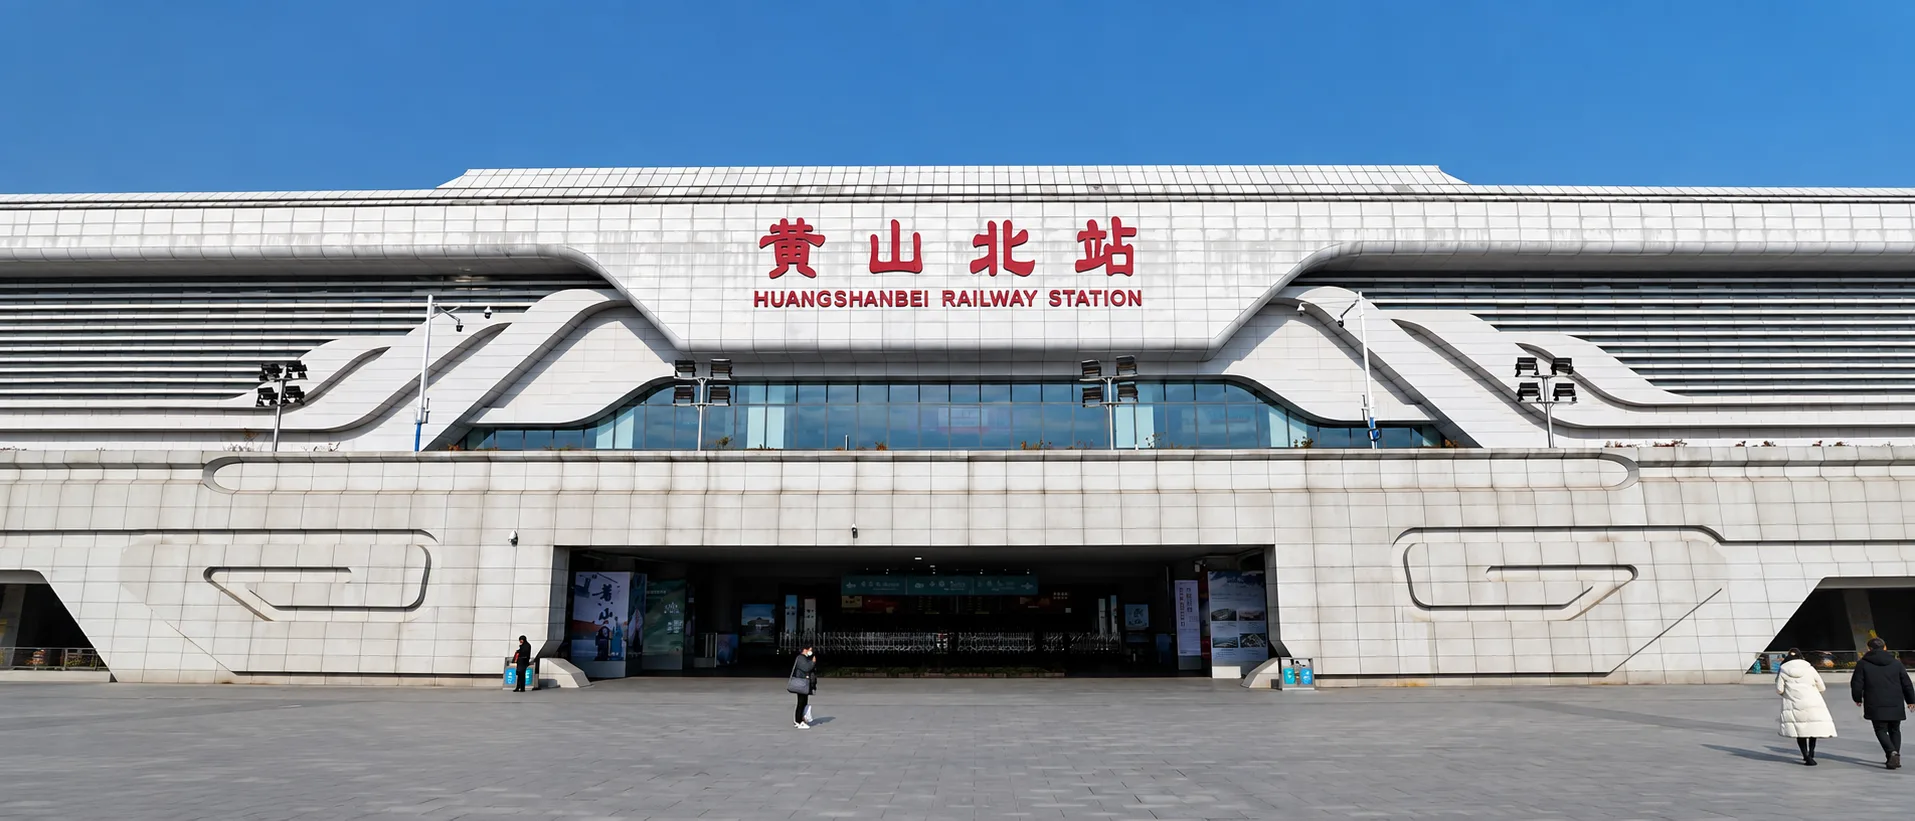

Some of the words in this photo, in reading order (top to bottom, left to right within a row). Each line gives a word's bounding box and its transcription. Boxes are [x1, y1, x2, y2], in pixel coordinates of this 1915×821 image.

[758, 215, 1138, 280] 黄山北站
[753, 289, 929, 308] HUANGSHANBEI
[942, 289, 1038, 308] RAILWAY
[1048, 289, 1142, 308] STATION
